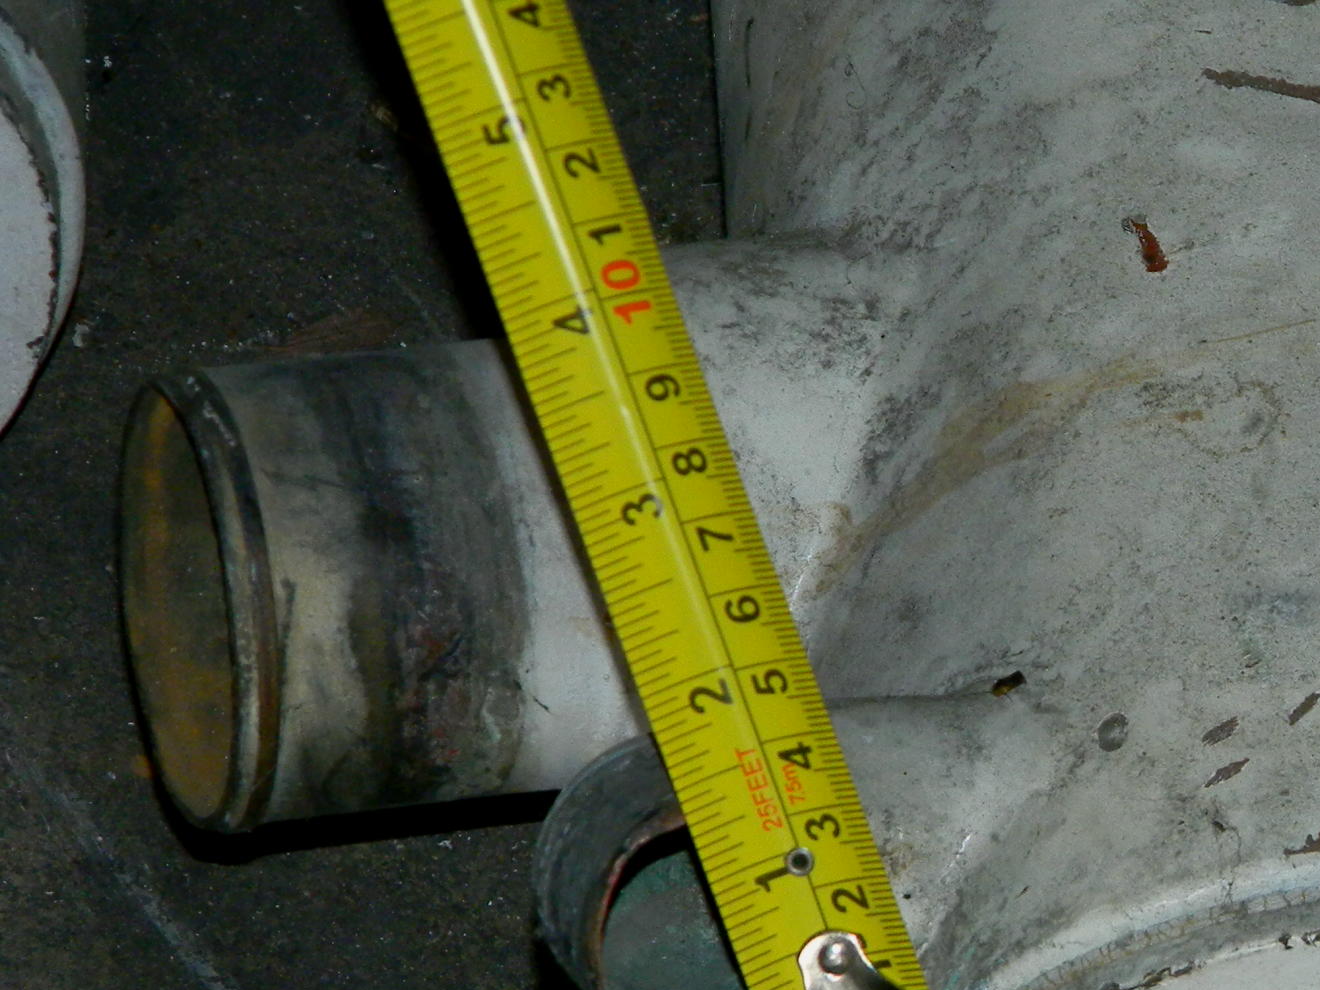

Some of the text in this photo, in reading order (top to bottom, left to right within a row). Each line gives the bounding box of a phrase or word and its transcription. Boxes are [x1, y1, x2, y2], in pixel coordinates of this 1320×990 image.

[508, 2, 540, 27] 4
[536, 75, 572, 101] 3
[482, 117, 527, 145] 5
[564, 147, 601, 178] 2
[588, 223, 621, 246] 1
[600, 259, 653, 325] 10
[554, 305, 594, 335] 4
[645, 373, 681, 401] 9
[671, 447, 707, 476] 8
[620, 492, 664, 526] 3
[695, 526, 733, 551] 7
[725, 595, 761, 623] 6
[689, 678, 734, 714] 2
[752, 669, 788, 695] 5
[777, 741, 812, 770] 4
[734, 748, 784, 833] 25FEET
[804, 813, 840, 841] 3
[753, 866, 790, 893] 1
[830, 884, 869, 913] 2
